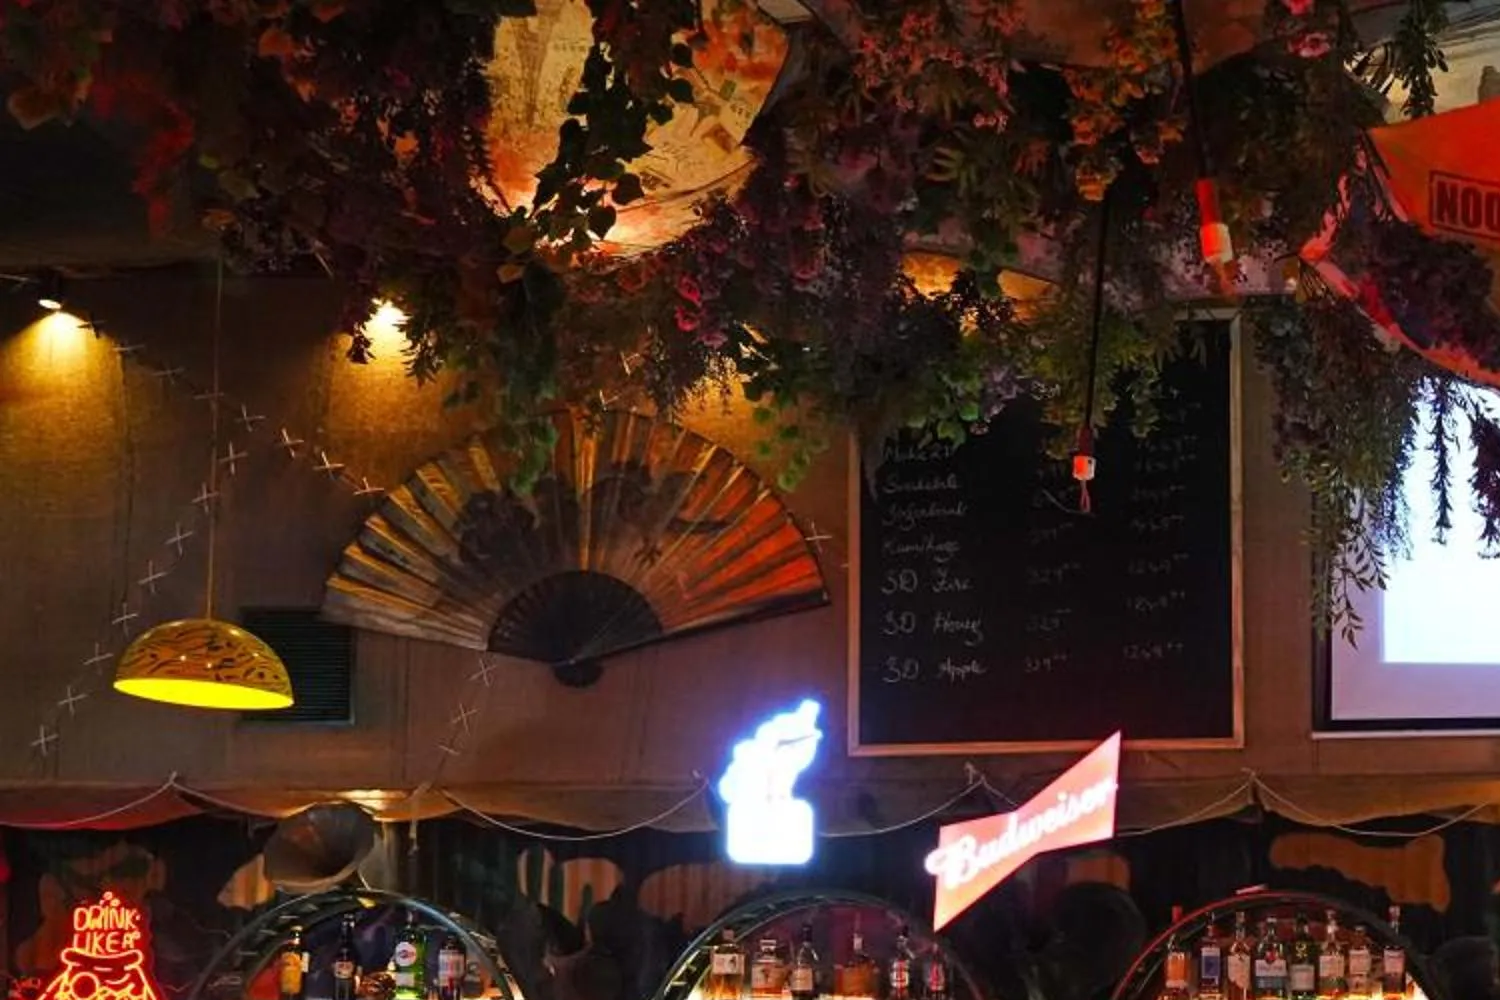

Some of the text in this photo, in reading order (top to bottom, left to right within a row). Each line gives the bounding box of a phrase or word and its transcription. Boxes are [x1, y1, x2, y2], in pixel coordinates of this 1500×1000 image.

[925, 777, 1118, 889] Budweiser
[73, 906, 137, 931] DRINK
[72, 931, 136, 956] LIKE A
